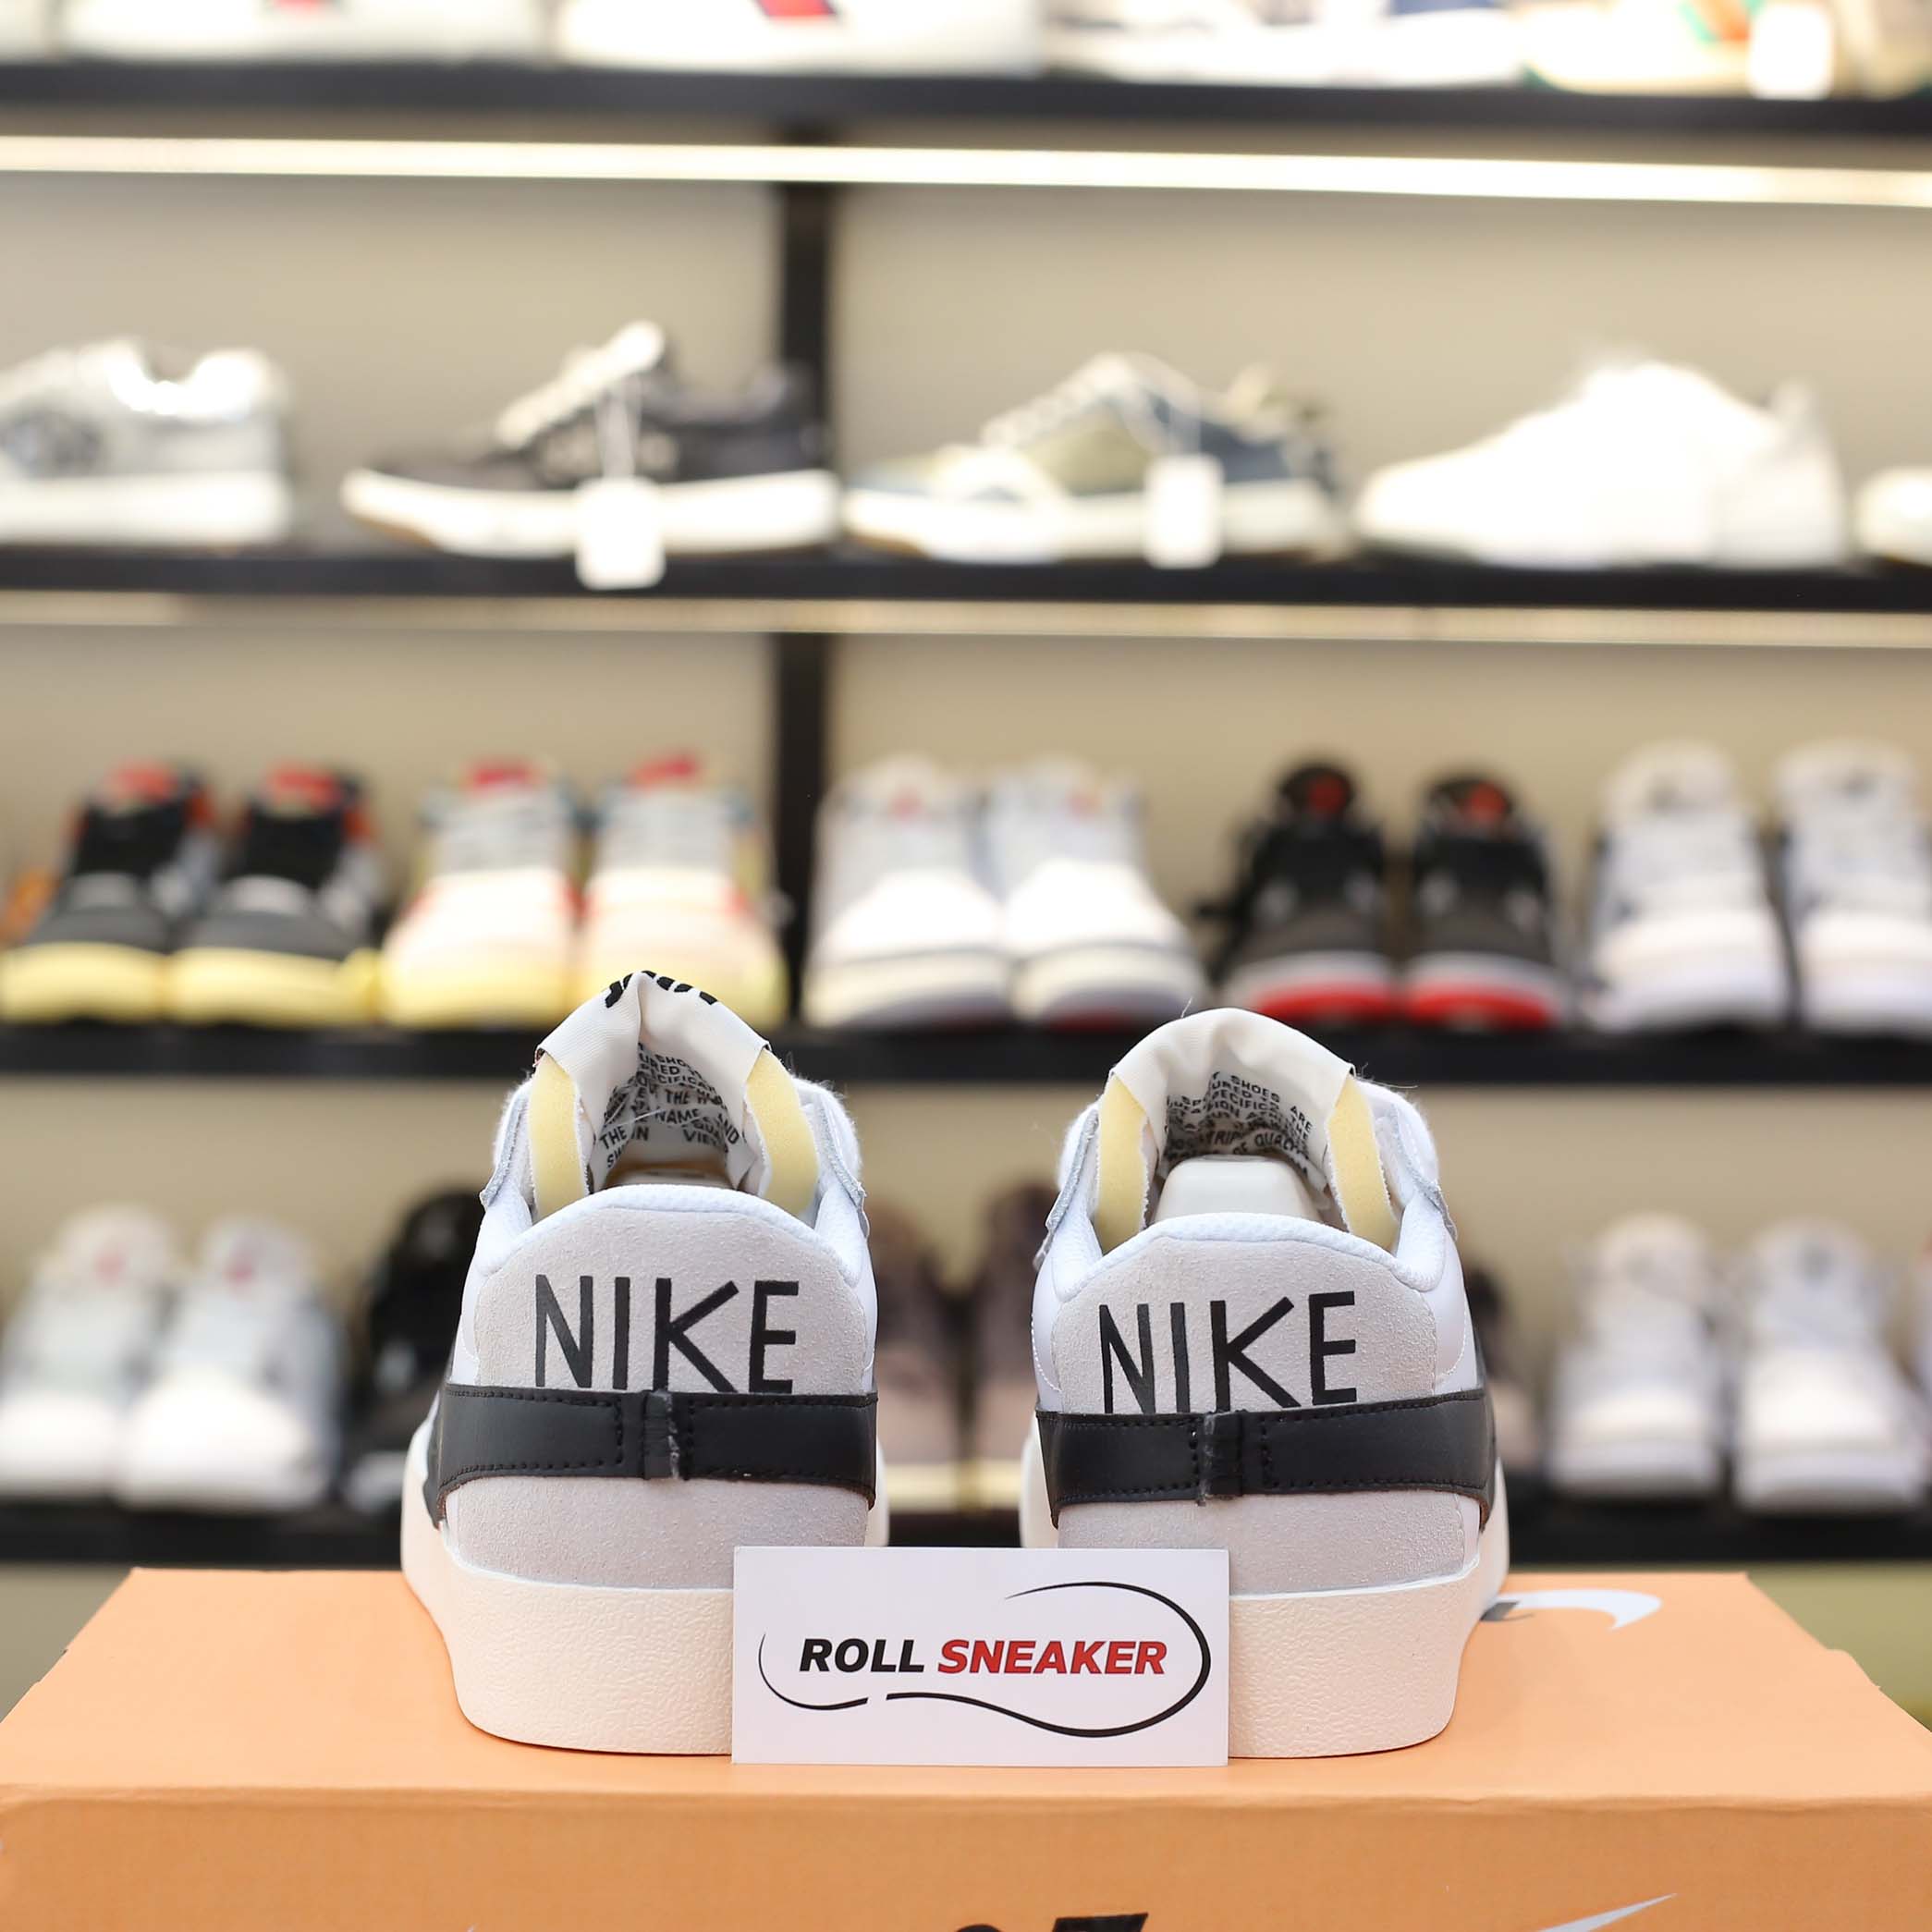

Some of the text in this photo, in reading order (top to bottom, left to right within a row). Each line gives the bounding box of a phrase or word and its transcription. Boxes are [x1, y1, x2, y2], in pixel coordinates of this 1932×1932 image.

[654, 1107, 700, 1125] NAME
[665, 1089, 690, 1106] THE
[1230, 1075, 1280, 1103] SHOES
[1290, 1106, 1313, 1133] ARE
[599, 1126, 628, 1150] THE
[535, 1274, 799, 1393] NIKE
[1099, 1290, 1357, 1414] NIKE
[799, 1638, 1168, 1675] ROLL SNEAKER
